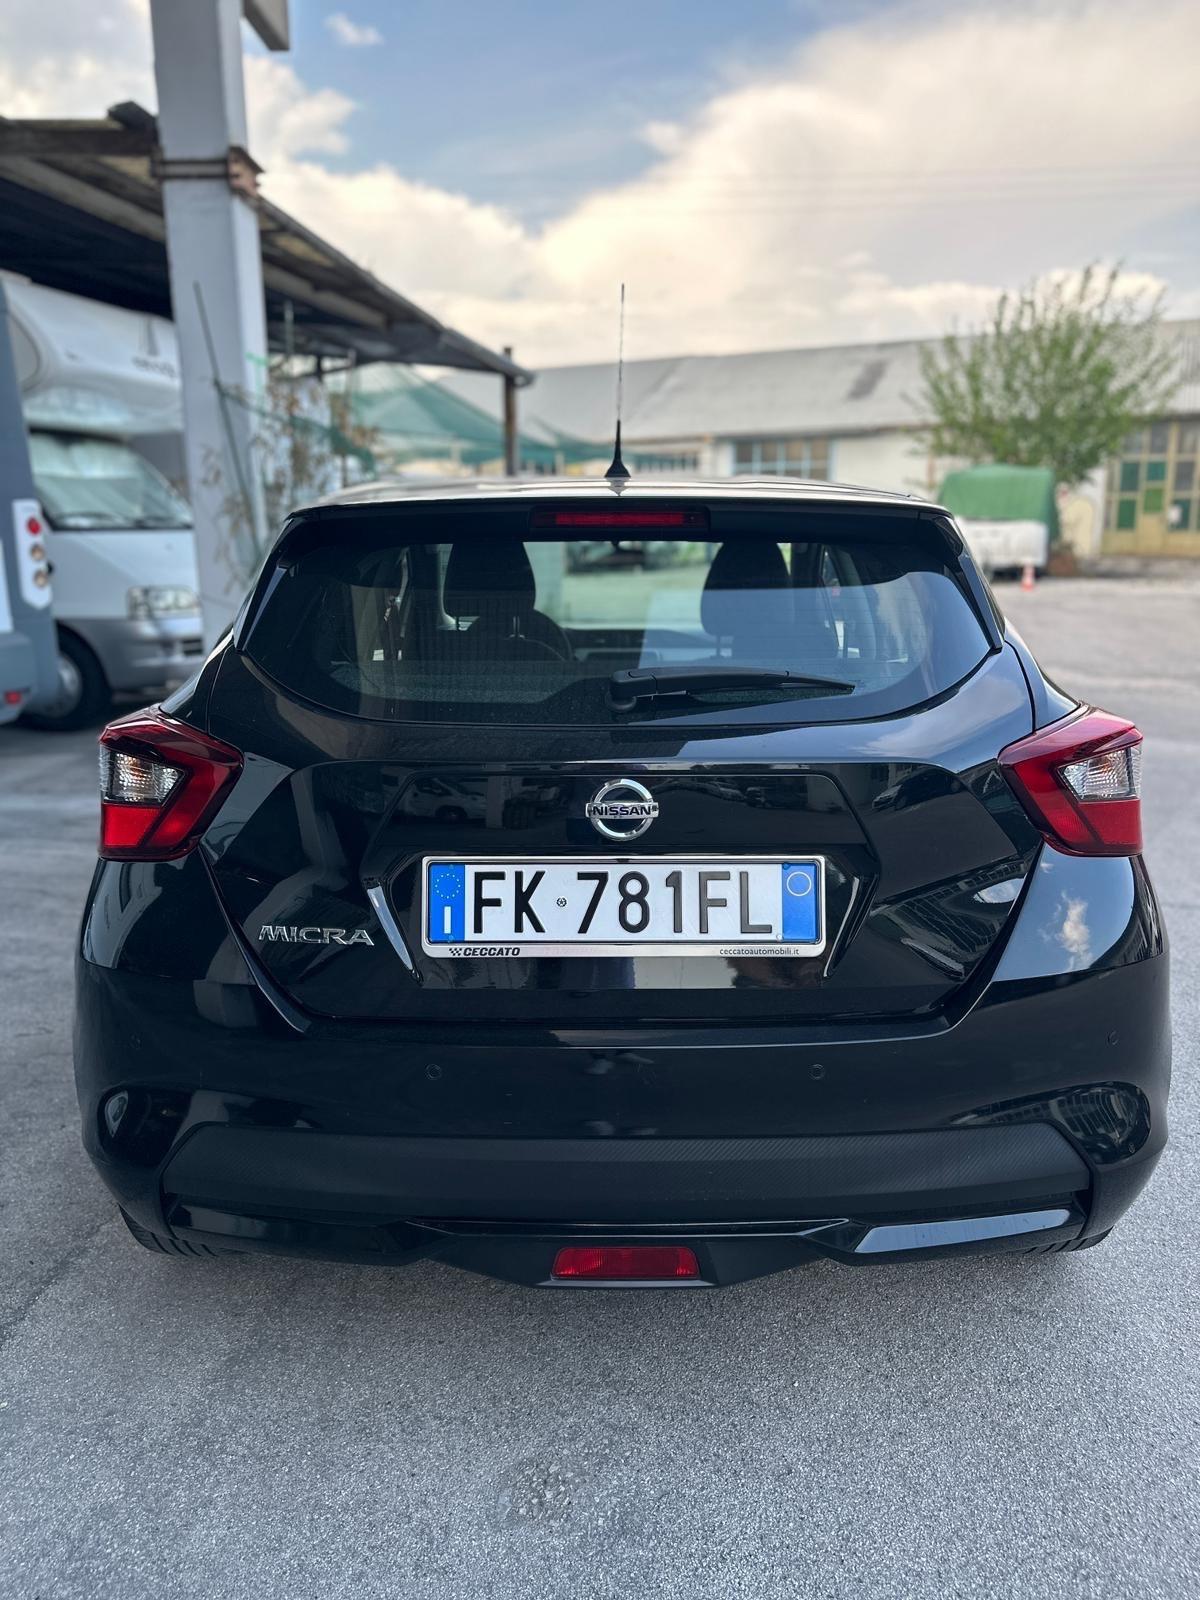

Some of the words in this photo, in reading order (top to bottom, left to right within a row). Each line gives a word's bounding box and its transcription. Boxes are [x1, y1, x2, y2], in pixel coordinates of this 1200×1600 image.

[592, 805, 652, 816] NISSAN
[473, 870, 546, 934] FK
[577, 870, 773, 934] 781FL
[443, 905, 452, 934] I
[258, 925, 375, 946] MICRA
[463, 947, 521, 957] CECCATO
[719, 947, 800, 956] ceccatoautomobili.it
